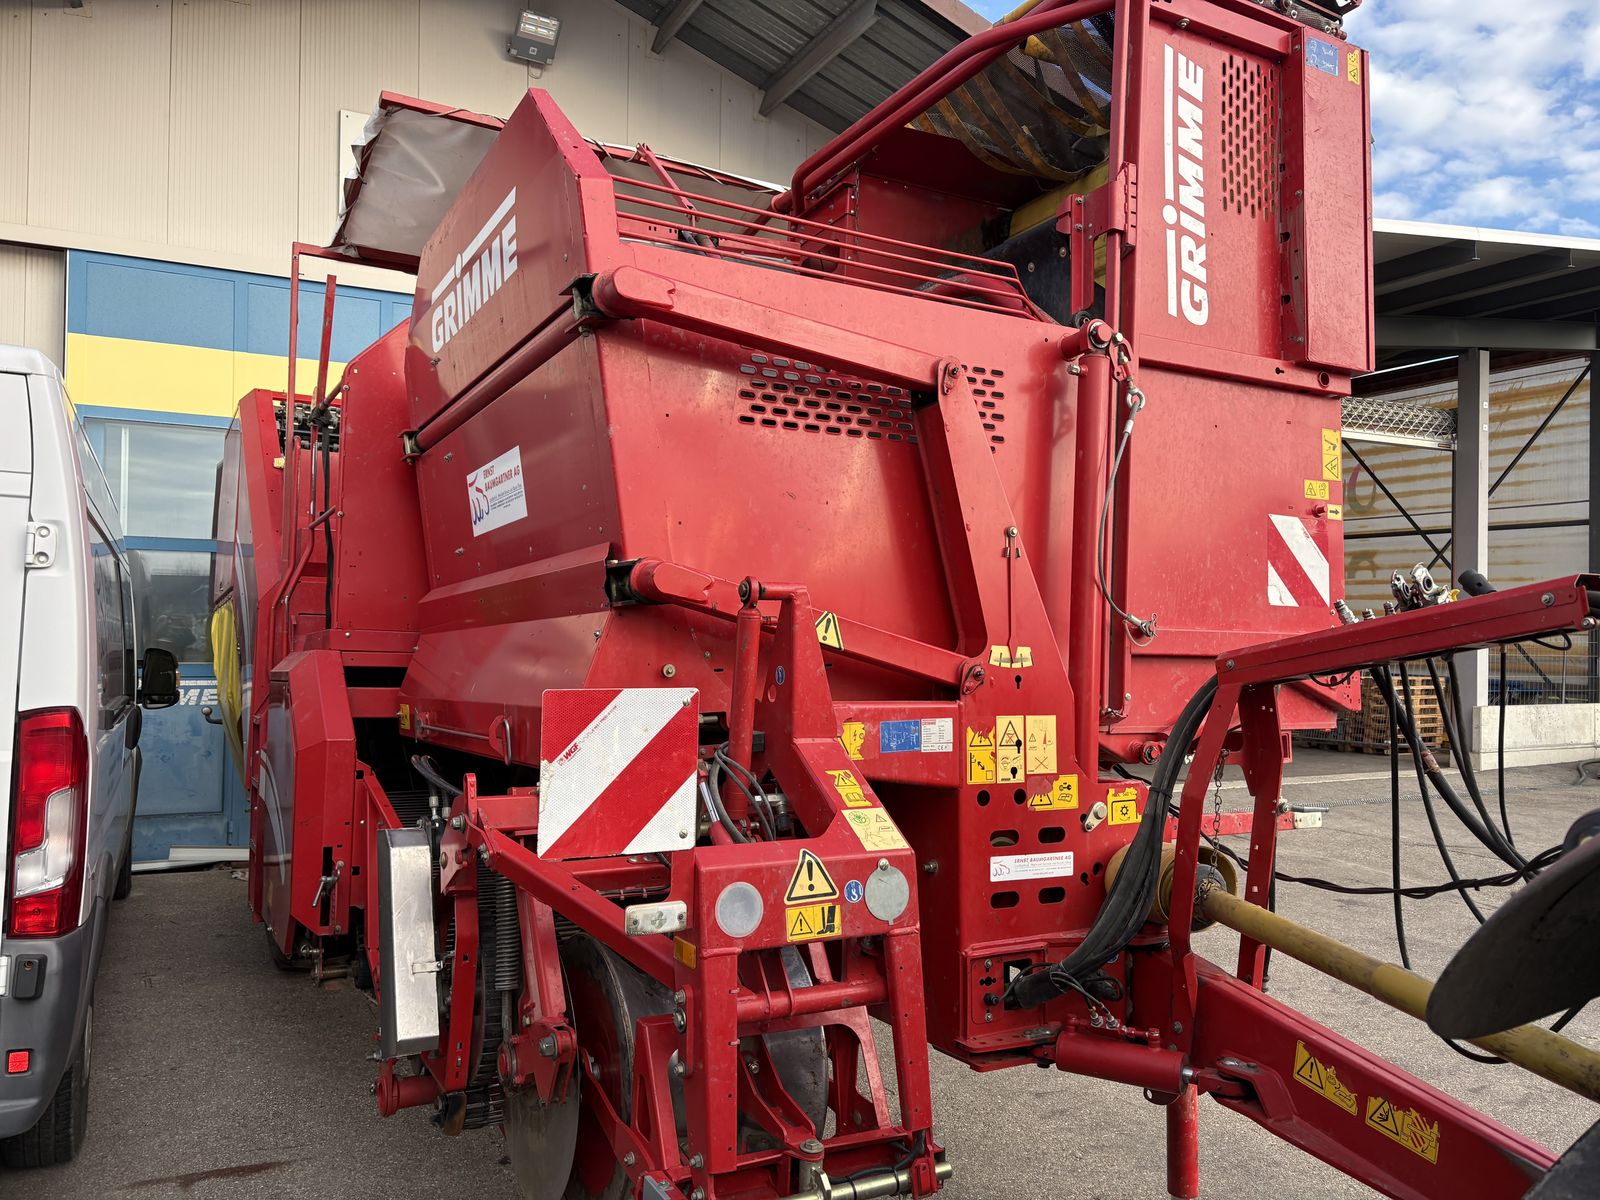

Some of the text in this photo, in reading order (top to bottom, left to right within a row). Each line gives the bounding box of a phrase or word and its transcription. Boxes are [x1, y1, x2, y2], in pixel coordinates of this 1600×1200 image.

[1163, 52, 1209, 326] GRIMME
[431, 214, 518, 353] GRIMME
[483, 465, 495, 479] ERNST
[484, 465, 520, 492] BAUMGARTNER AG
